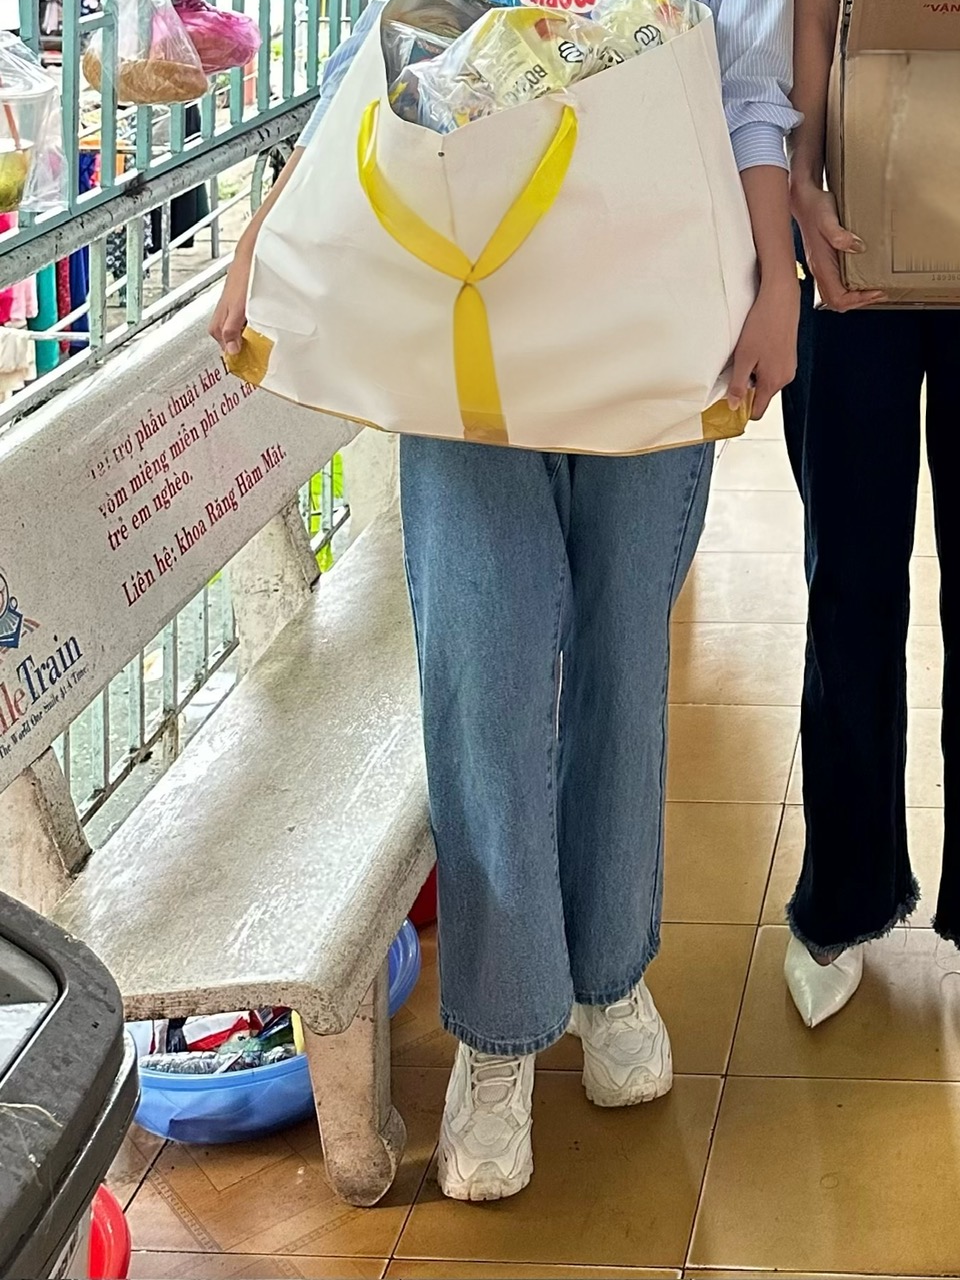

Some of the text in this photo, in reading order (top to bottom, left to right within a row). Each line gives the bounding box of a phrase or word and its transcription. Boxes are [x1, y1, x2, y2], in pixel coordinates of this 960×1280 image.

[129, 450, 170, 494] miệng
[169, 423, 200, 460] miễn
[200, 403, 220, 439] phí
[220, 389, 240, 416] cho
[134, 409, 168, 451] phẫu
[167, 384, 200, 418] thuật
[200, 368, 222, 393] khe
[107, 469, 194, 551] trẻ em nghèo.
[121, 568, 156, 607] Liên
[174, 520, 208, 556] khoa
[205, 488, 239, 526] Răng
[234, 465, 264, 499] Hàm
